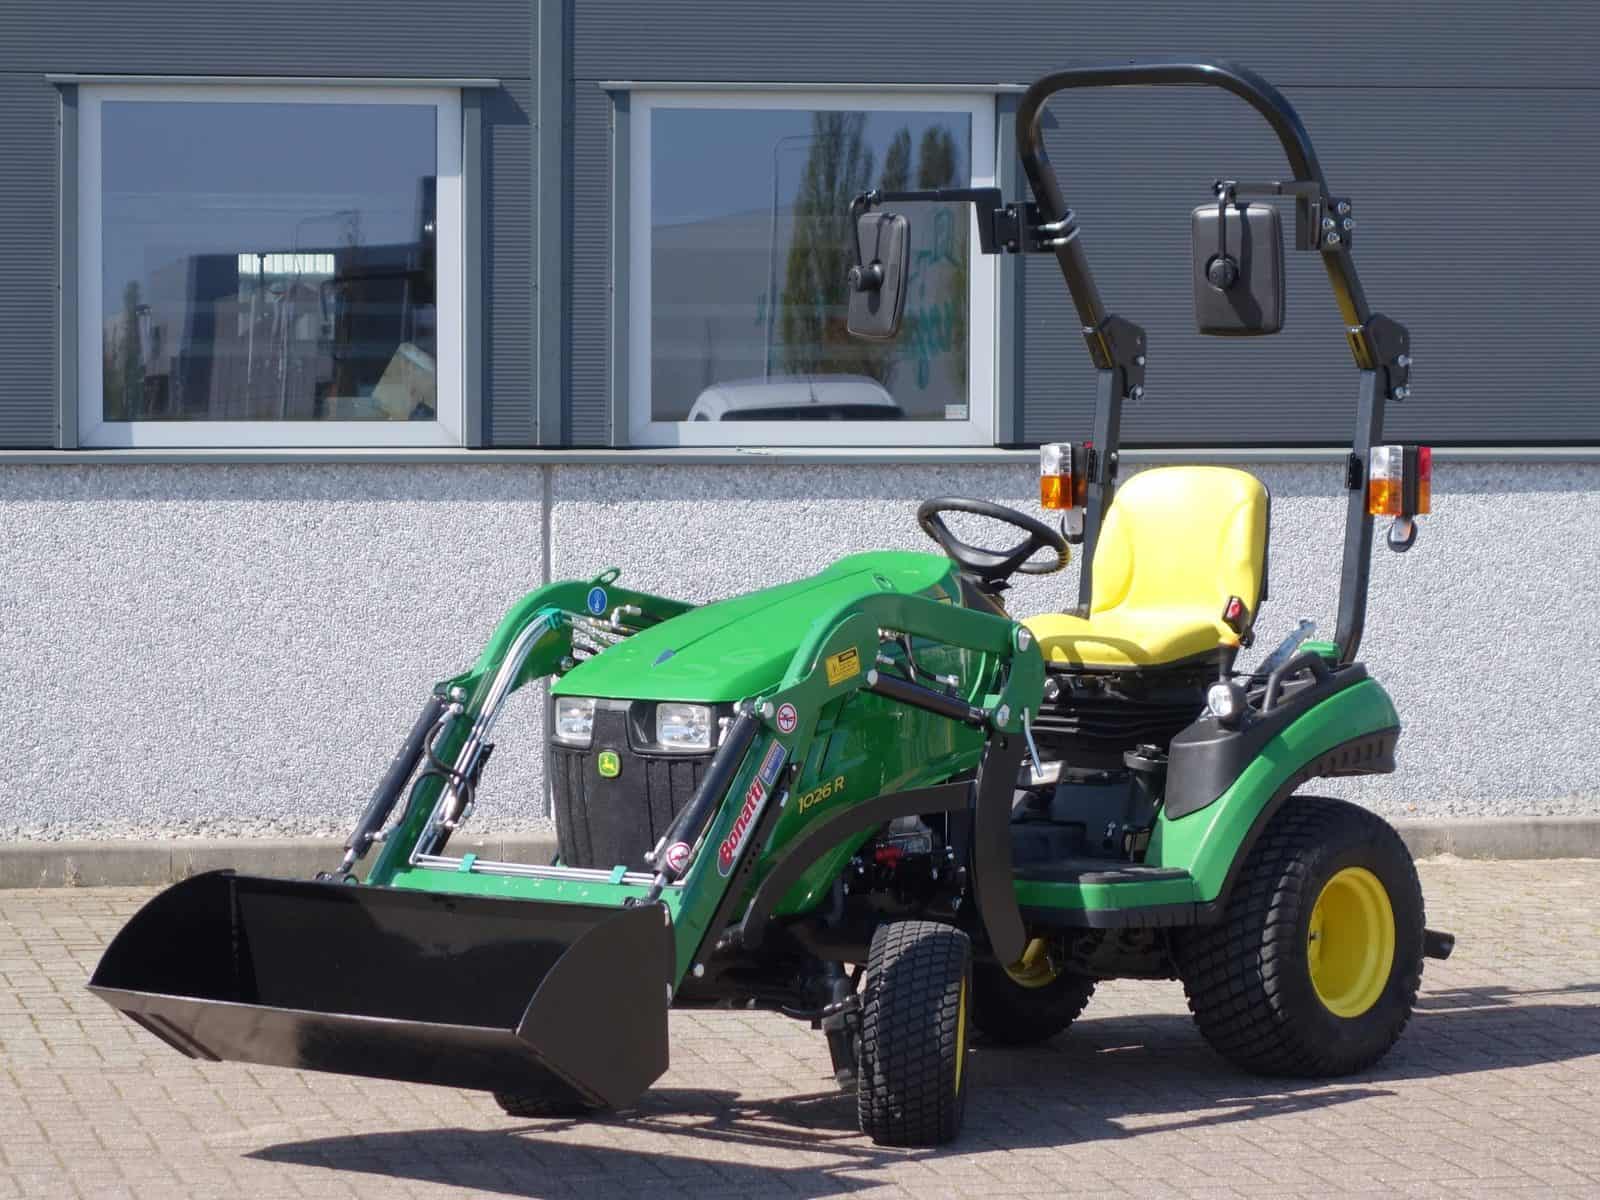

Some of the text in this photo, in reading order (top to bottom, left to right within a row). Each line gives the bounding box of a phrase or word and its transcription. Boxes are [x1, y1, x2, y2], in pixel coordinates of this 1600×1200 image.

[719, 776, 763, 865] Bonatti
[799, 776, 845, 814] 1026 R
